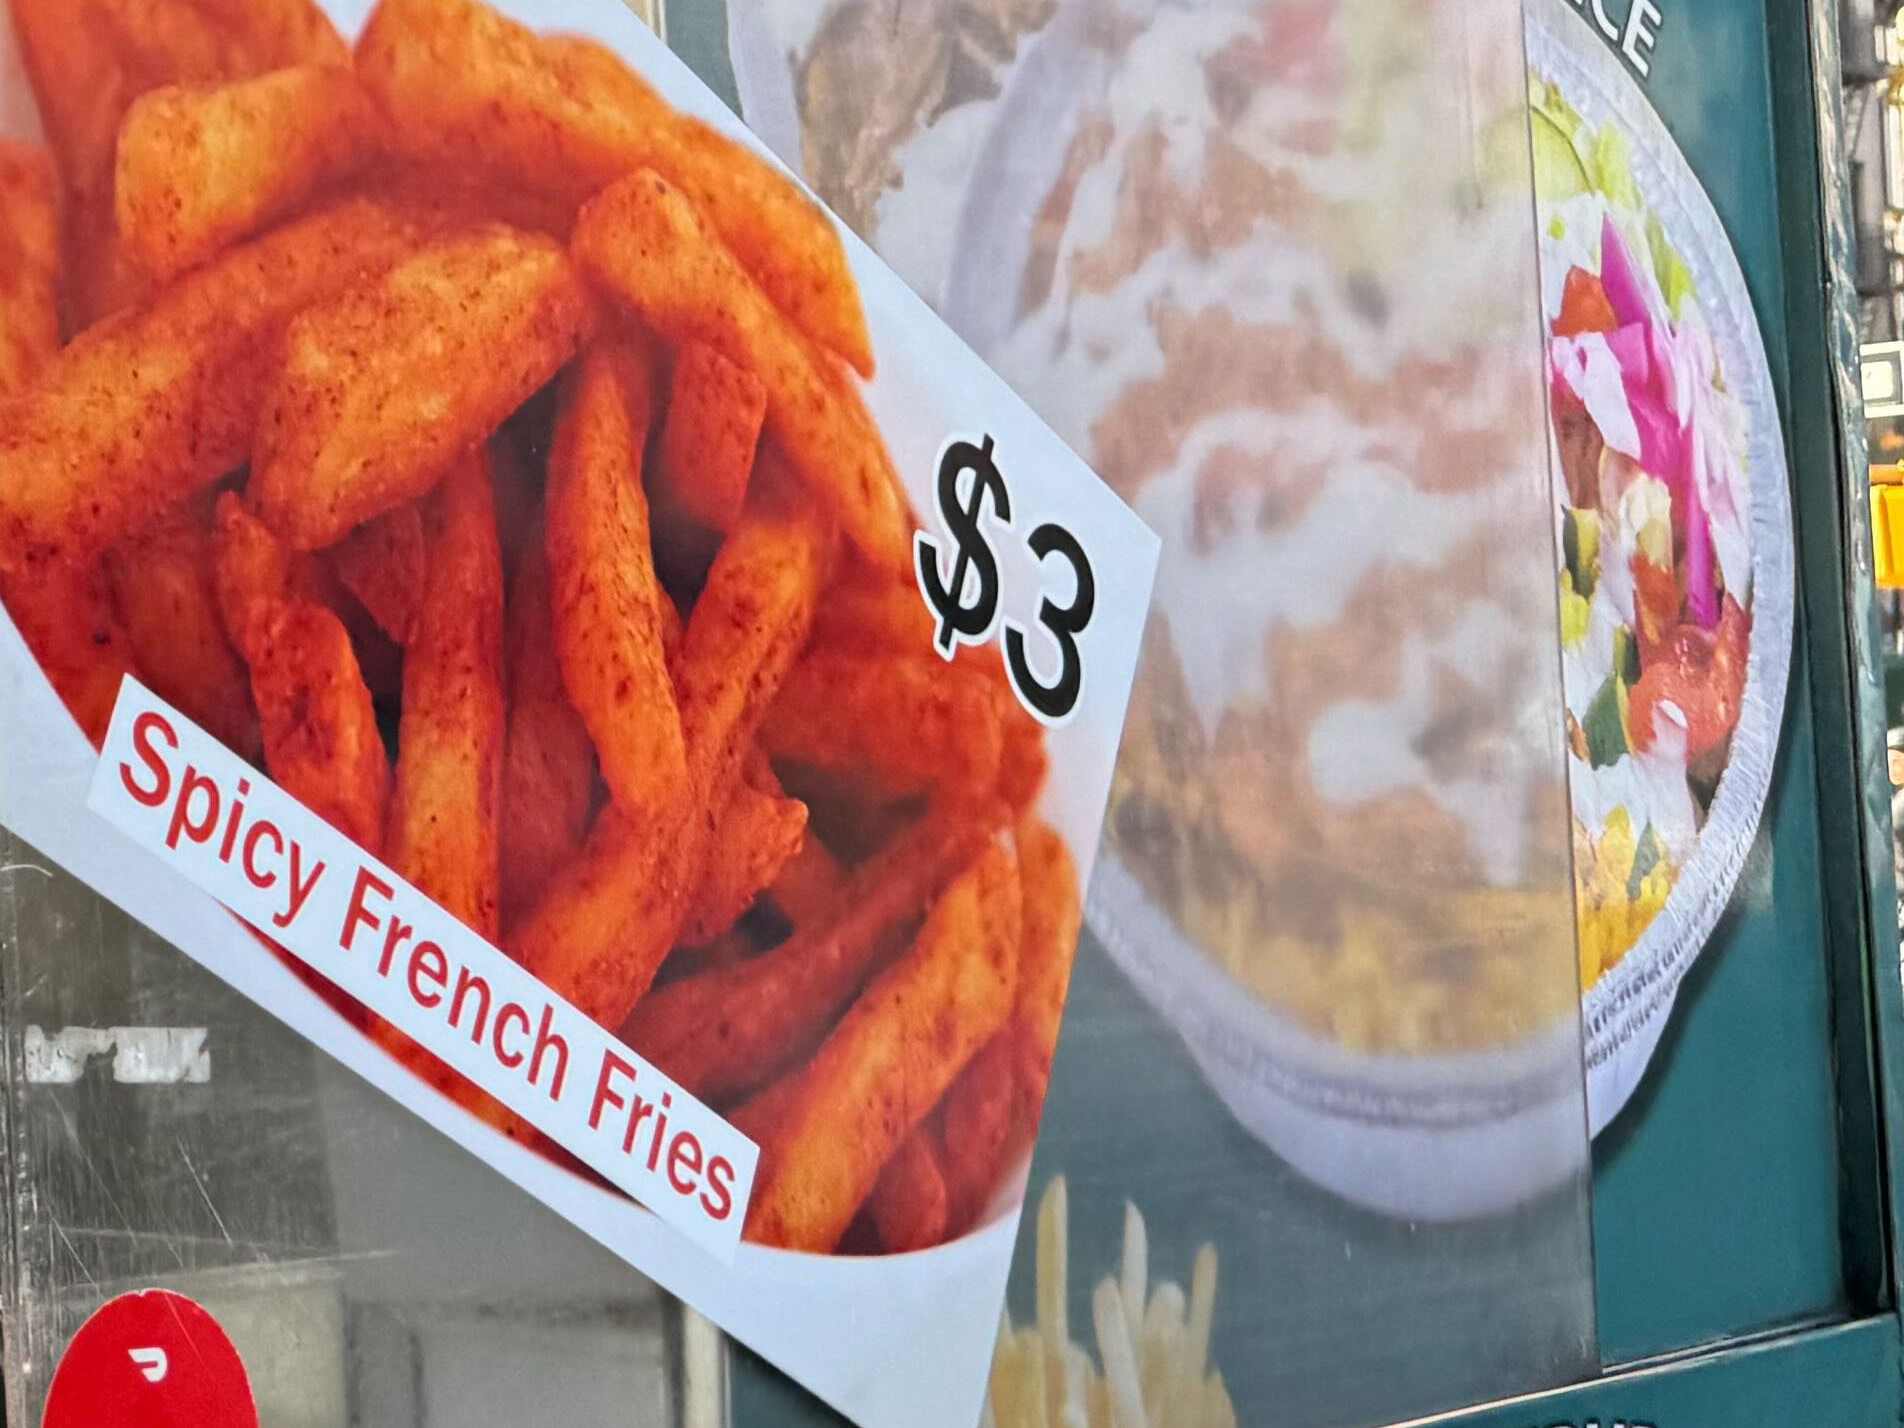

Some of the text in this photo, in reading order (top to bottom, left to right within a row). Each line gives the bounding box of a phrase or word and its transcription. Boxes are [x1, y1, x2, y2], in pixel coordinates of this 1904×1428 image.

[919, 433, 1095, 718] $3
[118, 710, 736, 1220] Spicy French Fries
